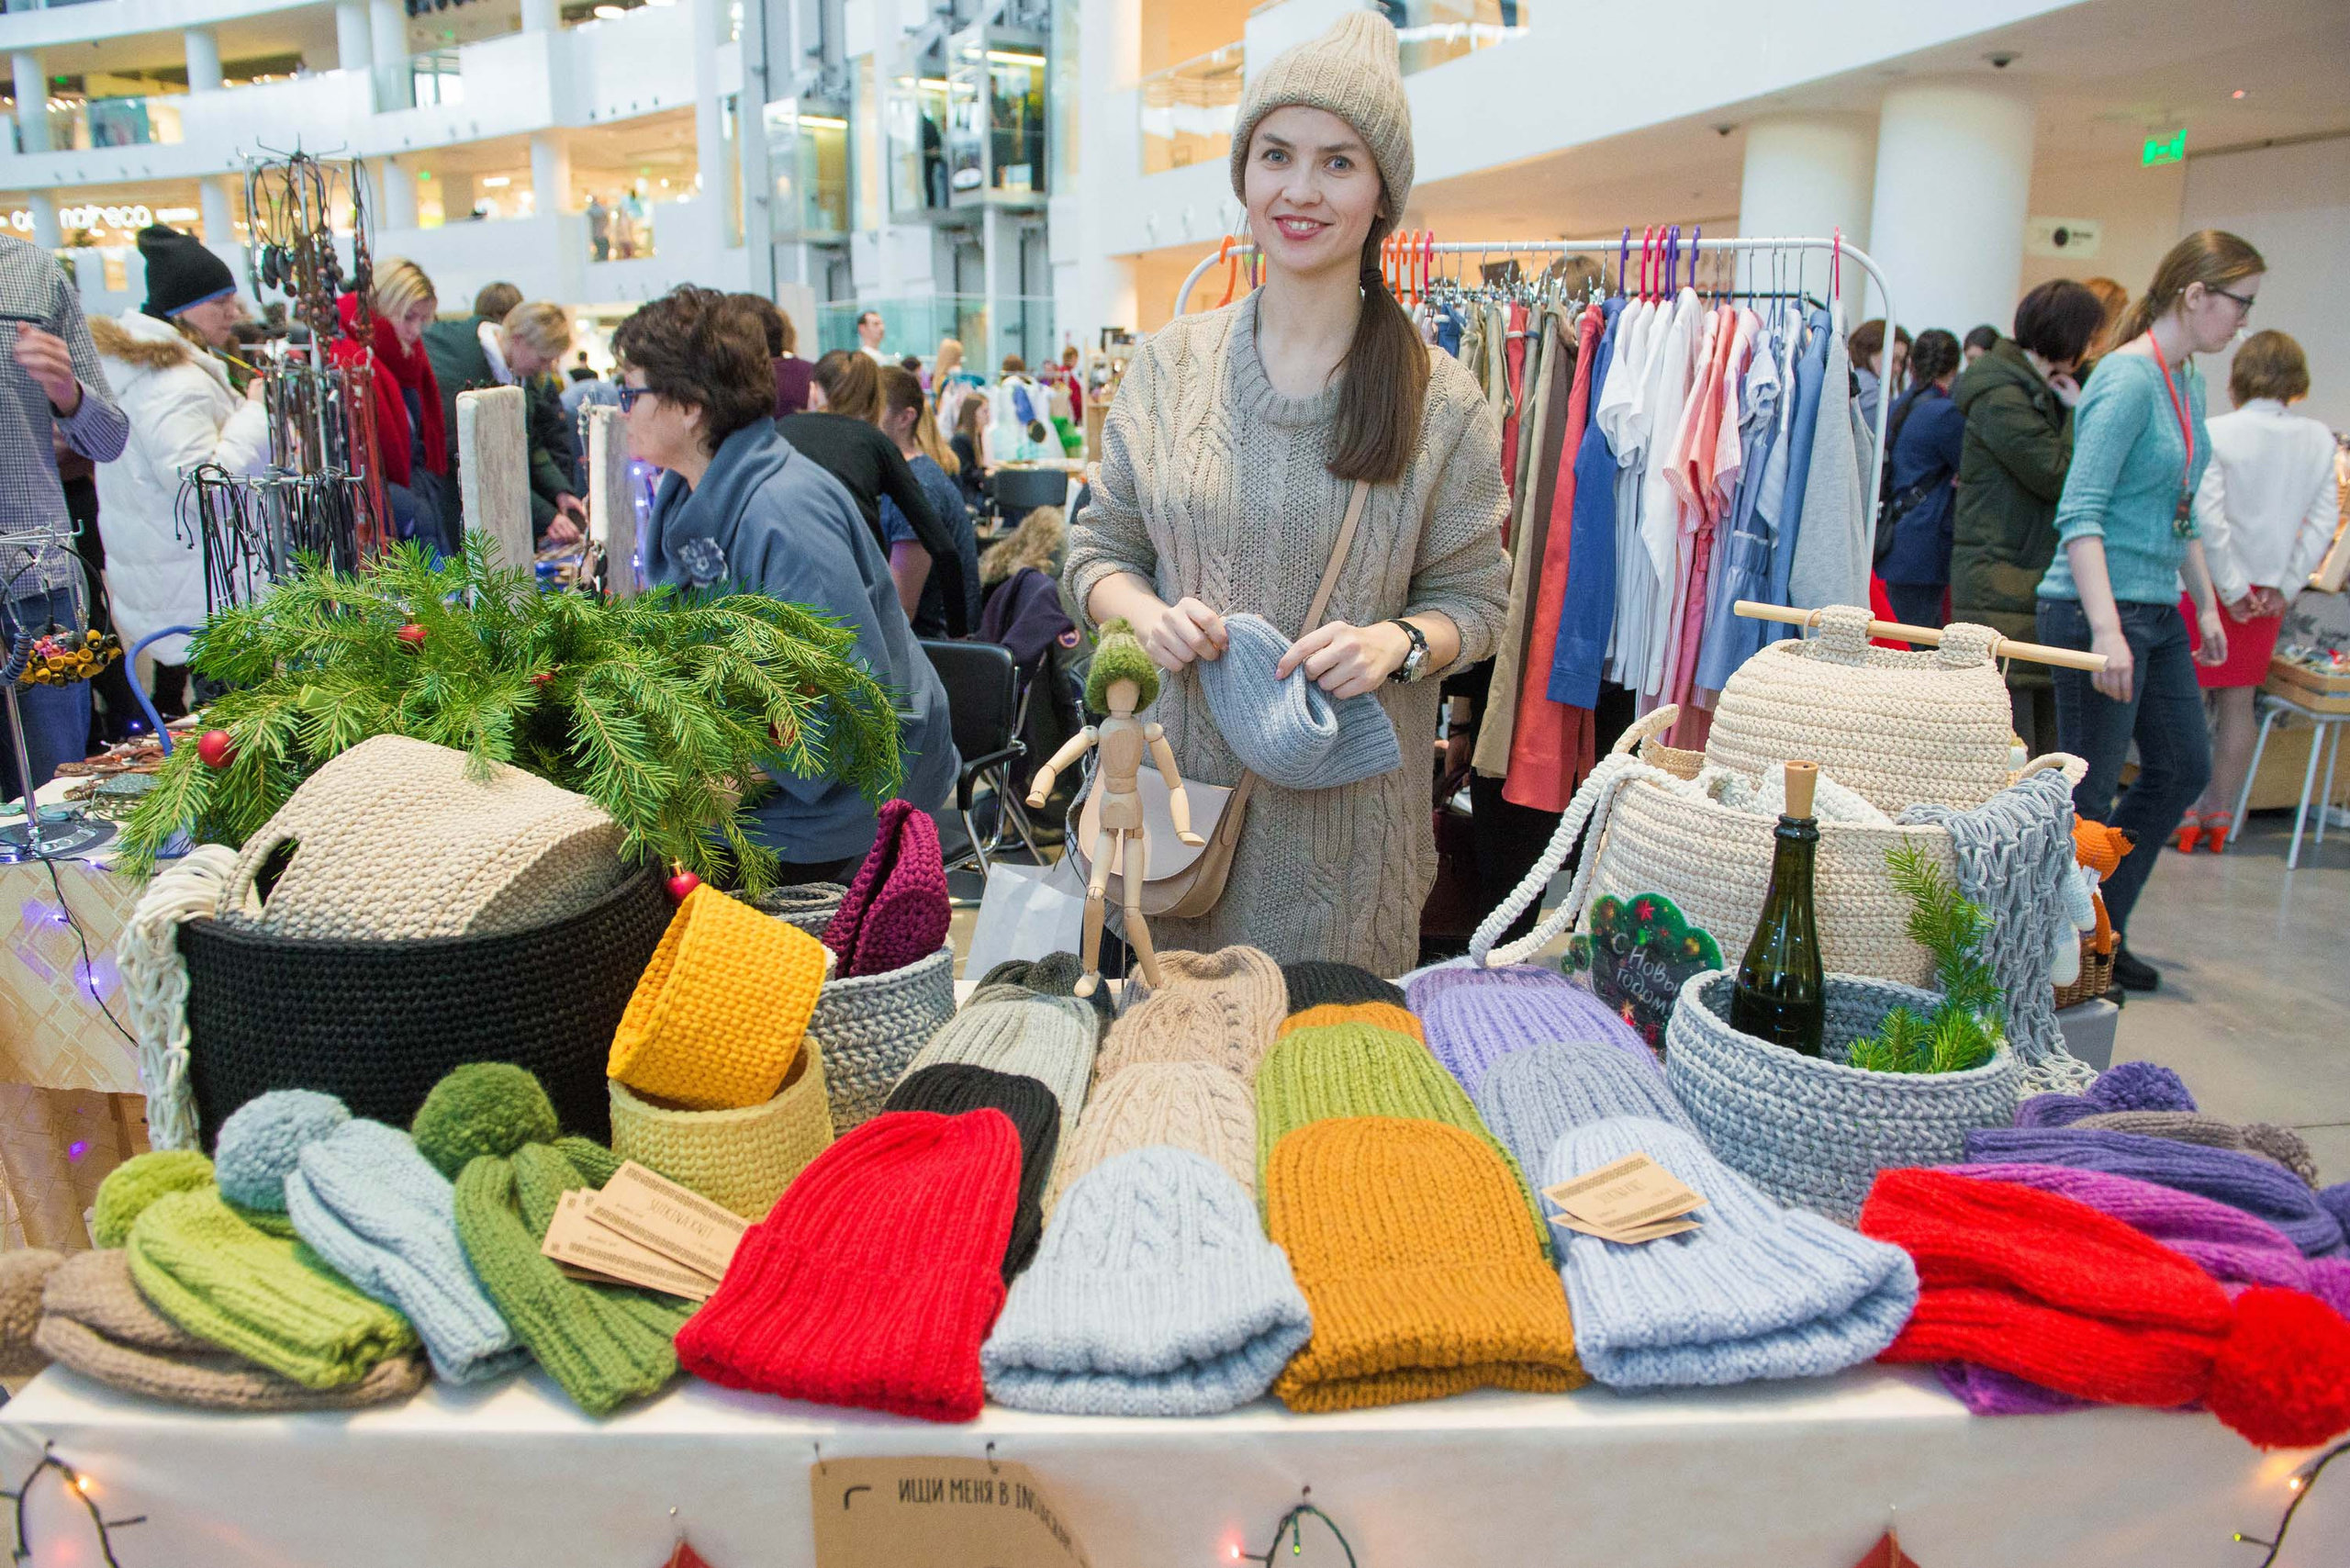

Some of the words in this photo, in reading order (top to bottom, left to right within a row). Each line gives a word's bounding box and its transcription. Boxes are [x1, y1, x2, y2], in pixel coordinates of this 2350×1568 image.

[898, 1478, 945, 1504] ИЩИ
[949, 1479, 993, 1505] МЕНЯ
[998, 1482, 1010, 1506] В
